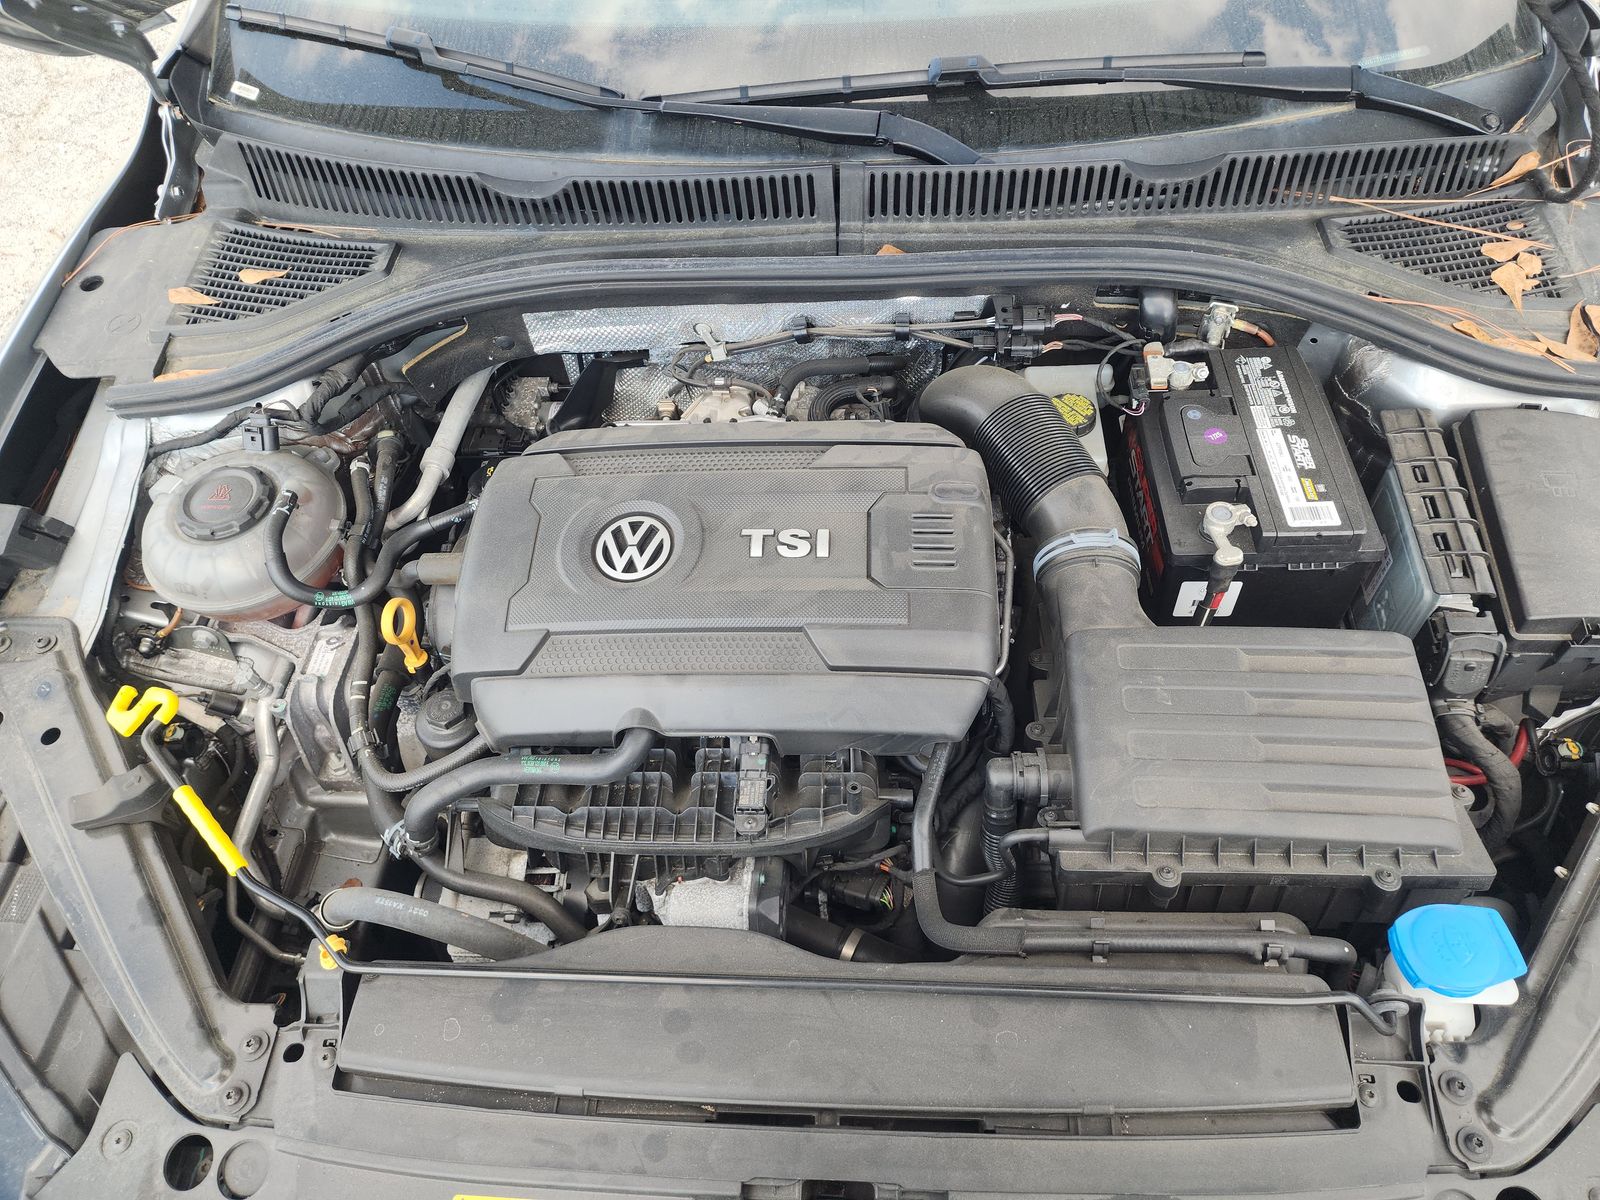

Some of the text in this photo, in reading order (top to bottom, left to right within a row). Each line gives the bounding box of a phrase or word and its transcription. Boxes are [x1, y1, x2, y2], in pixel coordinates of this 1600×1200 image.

[1287, 434, 1305, 468] START
[1300, 438, 1317, 470] SUPER
[740, 528, 831, 559] TSI
